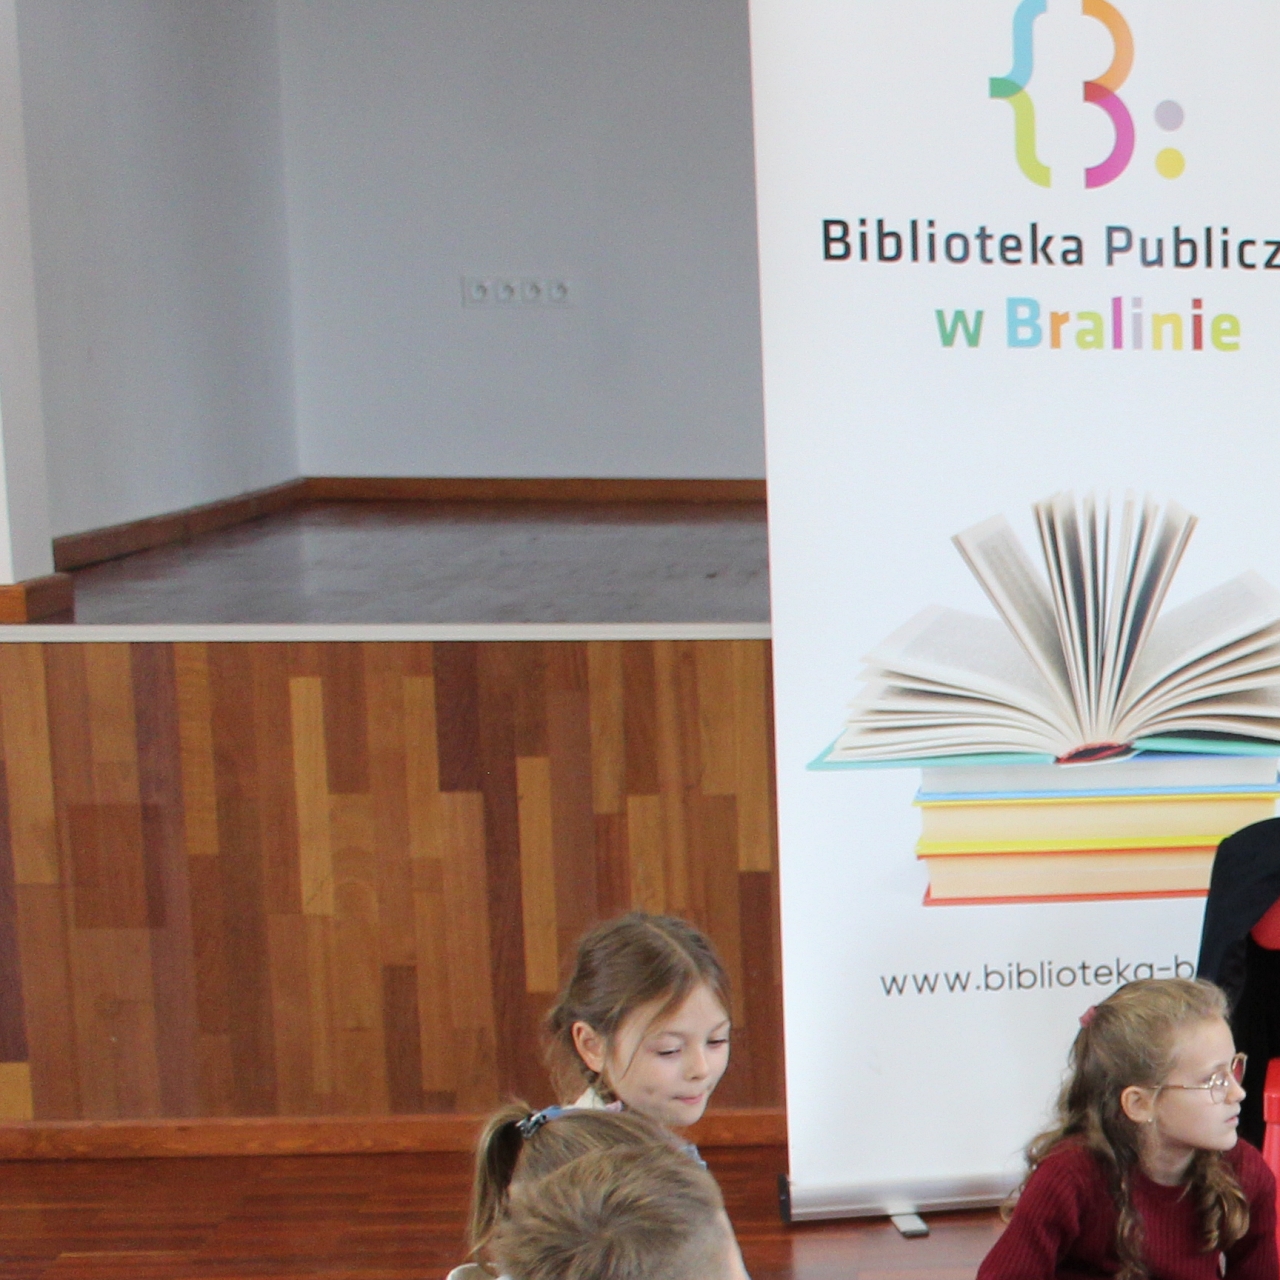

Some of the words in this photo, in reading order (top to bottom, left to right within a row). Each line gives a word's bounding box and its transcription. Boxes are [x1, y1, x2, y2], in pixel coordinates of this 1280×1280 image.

[822, 218, 1084, 267] Biblioteka
[935, 309, 984, 348] w
[1006, 296, 1241, 351] Bralinie
